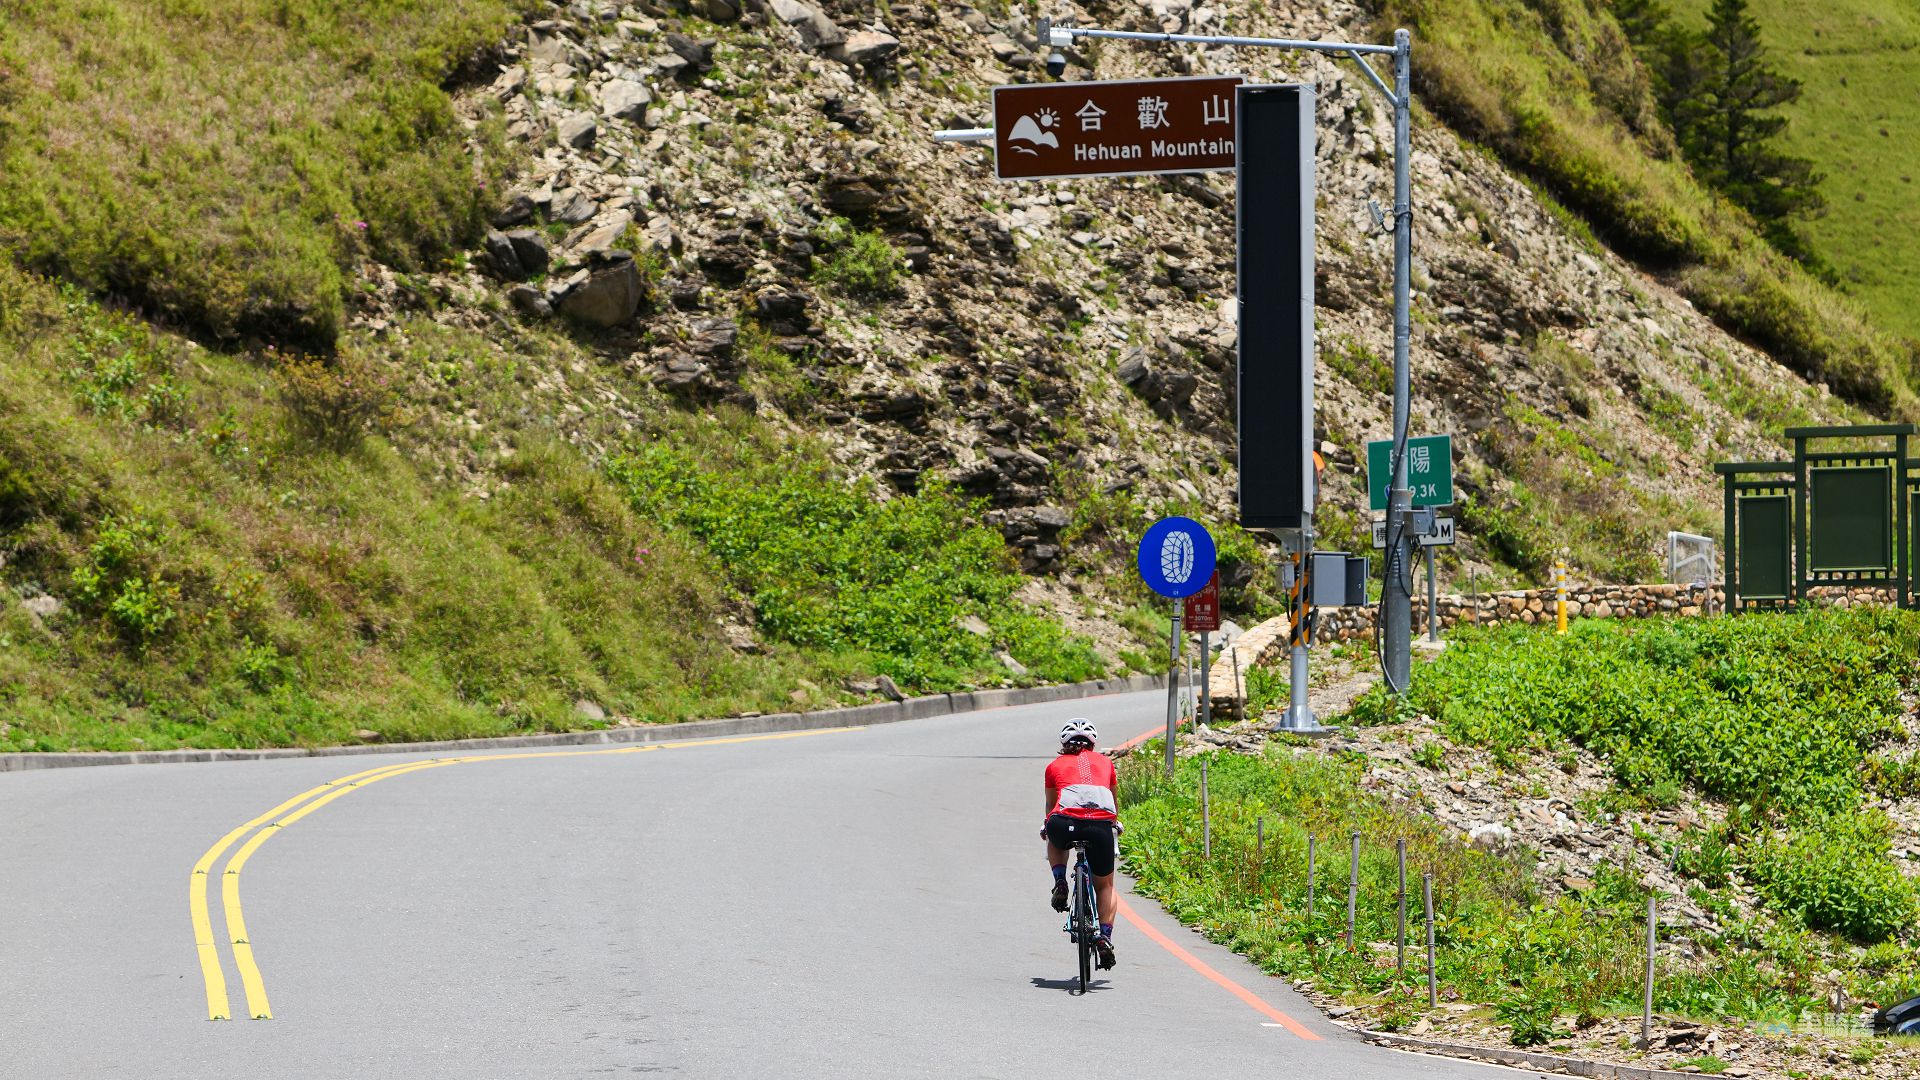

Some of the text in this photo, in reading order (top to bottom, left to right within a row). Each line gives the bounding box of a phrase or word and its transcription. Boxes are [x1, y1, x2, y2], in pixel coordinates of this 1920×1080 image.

[1074, 94, 1230, 132] 合歡山
[1074, 137, 1235, 161] Hehuan Mountain
